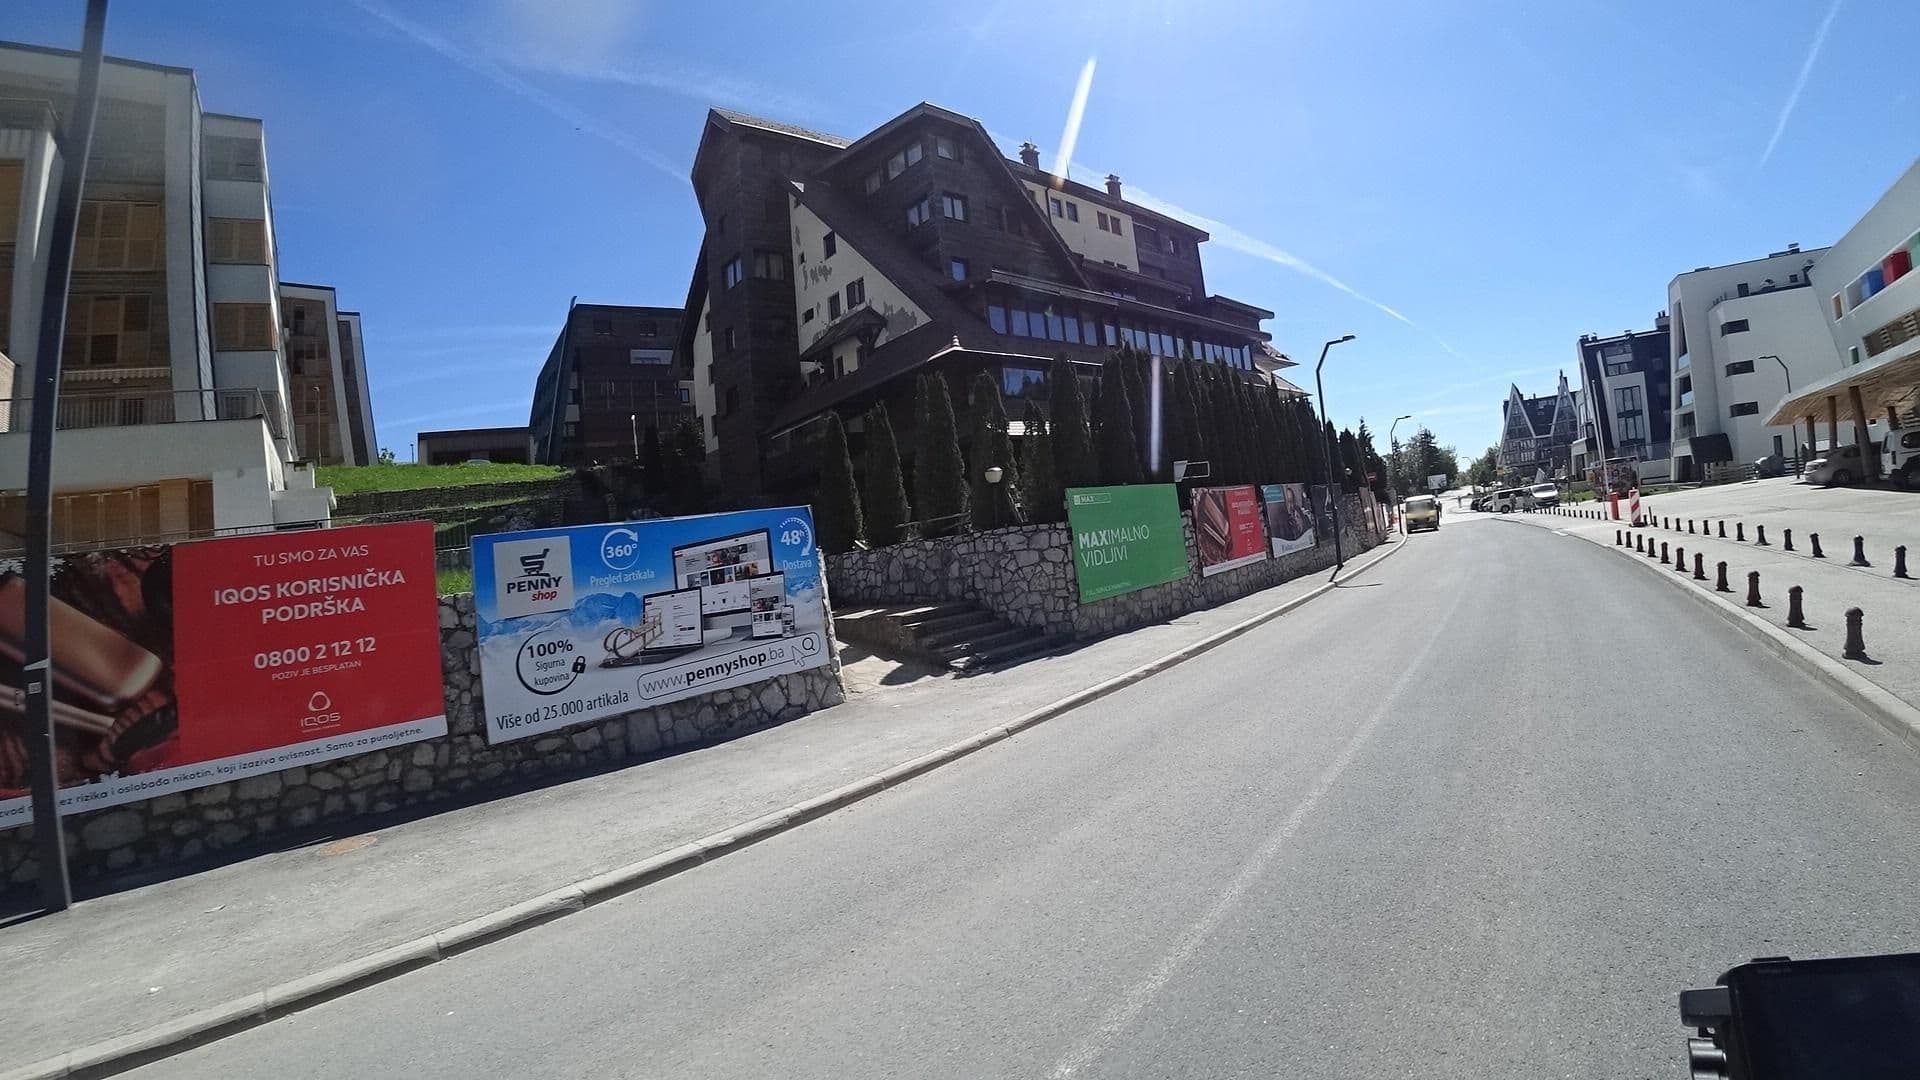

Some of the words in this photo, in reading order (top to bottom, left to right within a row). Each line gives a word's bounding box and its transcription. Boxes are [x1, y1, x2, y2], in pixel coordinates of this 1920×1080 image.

[1078, 524, 1150, 550] MAXIMALNO
[252, 554, 275, 567] TU
[278, 550, 314, 565] SMO
[318, 548, 338, 561] ZA
[340, 544, 369, 558] VAS
[606, 544, 638, 558] 360°
[1080, 545, 1128, 568] VIDLJIVI
[782, 559, 812, 570] Dostava
[214, 584, 272, 606] IQOS
[276, 567, 406, 598] KORISNIČKA
[506, 576, 562, 594] PENNY
[589, 574, 622, 588] Pregled
[624, 568, 656, 582] artikala
[531, 590, 558, 602] shop
[261, 594, 366, 624] PODRŠKA
[254, 646, 310, 669] 0800
[314, 644, 327, 660] 2
[331, 640, 352, 657] 12
[356, 636, 377, 653] 12
[526, 638, 574, 659] 100%
[271, 669, 299, 681] POZIV
[300, 667, 311, 677] JE
[312, 660, 362, 674] BESPLATAN
[536, 659, 566, 672] Sigurna
[642, 647, 786, 694] www.pennyshop.ba
[534, 672, 570, 686] kupovina
[300, 712, 341, 728] IQOS
[496, 713, 522, 730] Više
[524, 708, 540, 724] od
[543, 699, 584, 721] 25.000
[586, 690, 630, 711] artikala
[76, 790, 108, 802] rizika
[117, 776, 170, 795] oslobađa
[172, 766, 215, 784] nikotin,
[216, 764, 237, 777] koji
[238, 755, 276, 770] izaziva
[278, 746, 322, 762] ovisnost.
[326, 740, 354, 752] Samo
[356, 737, 368, 746] za
[370, 726, 425, 745] punoljetne.
